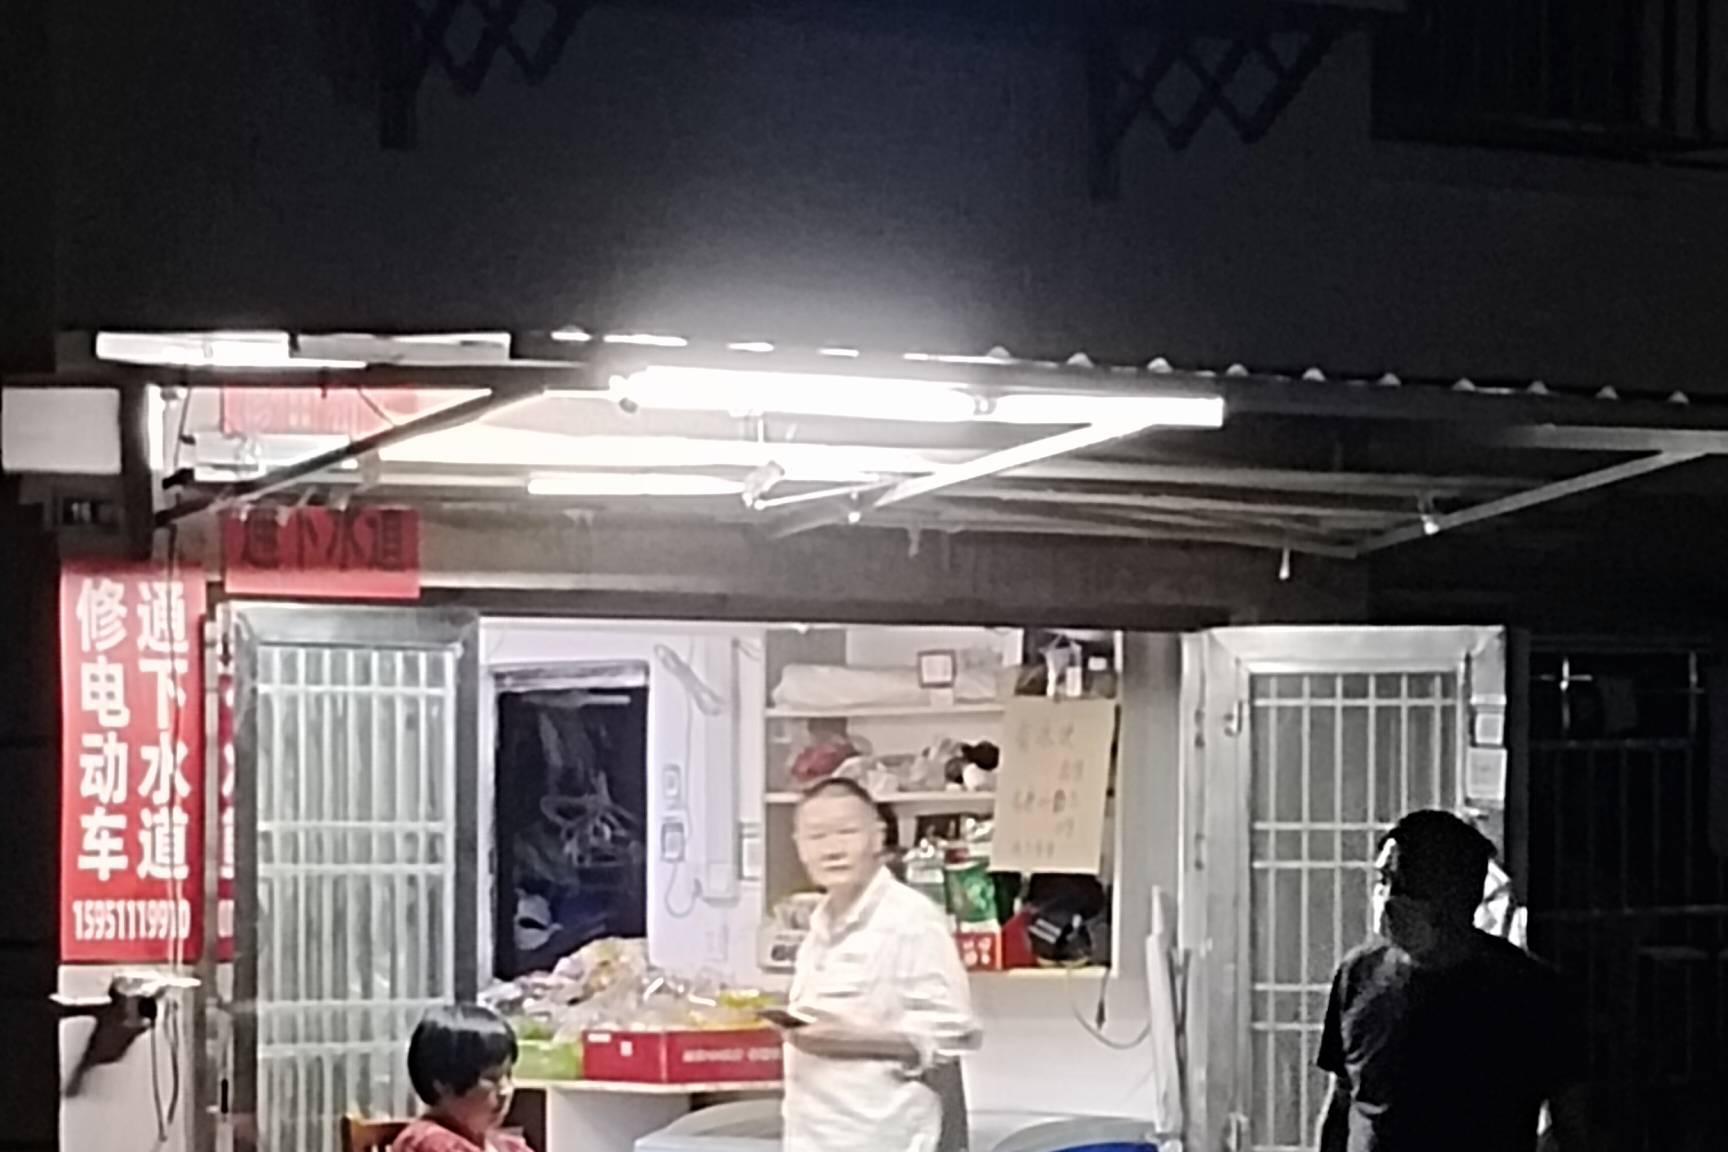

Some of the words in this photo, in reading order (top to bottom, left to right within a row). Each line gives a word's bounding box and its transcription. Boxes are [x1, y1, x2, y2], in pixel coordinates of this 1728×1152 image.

[77, 577, 130, 882] 修电动车
[136, 581, 192, 882] 通下水道
